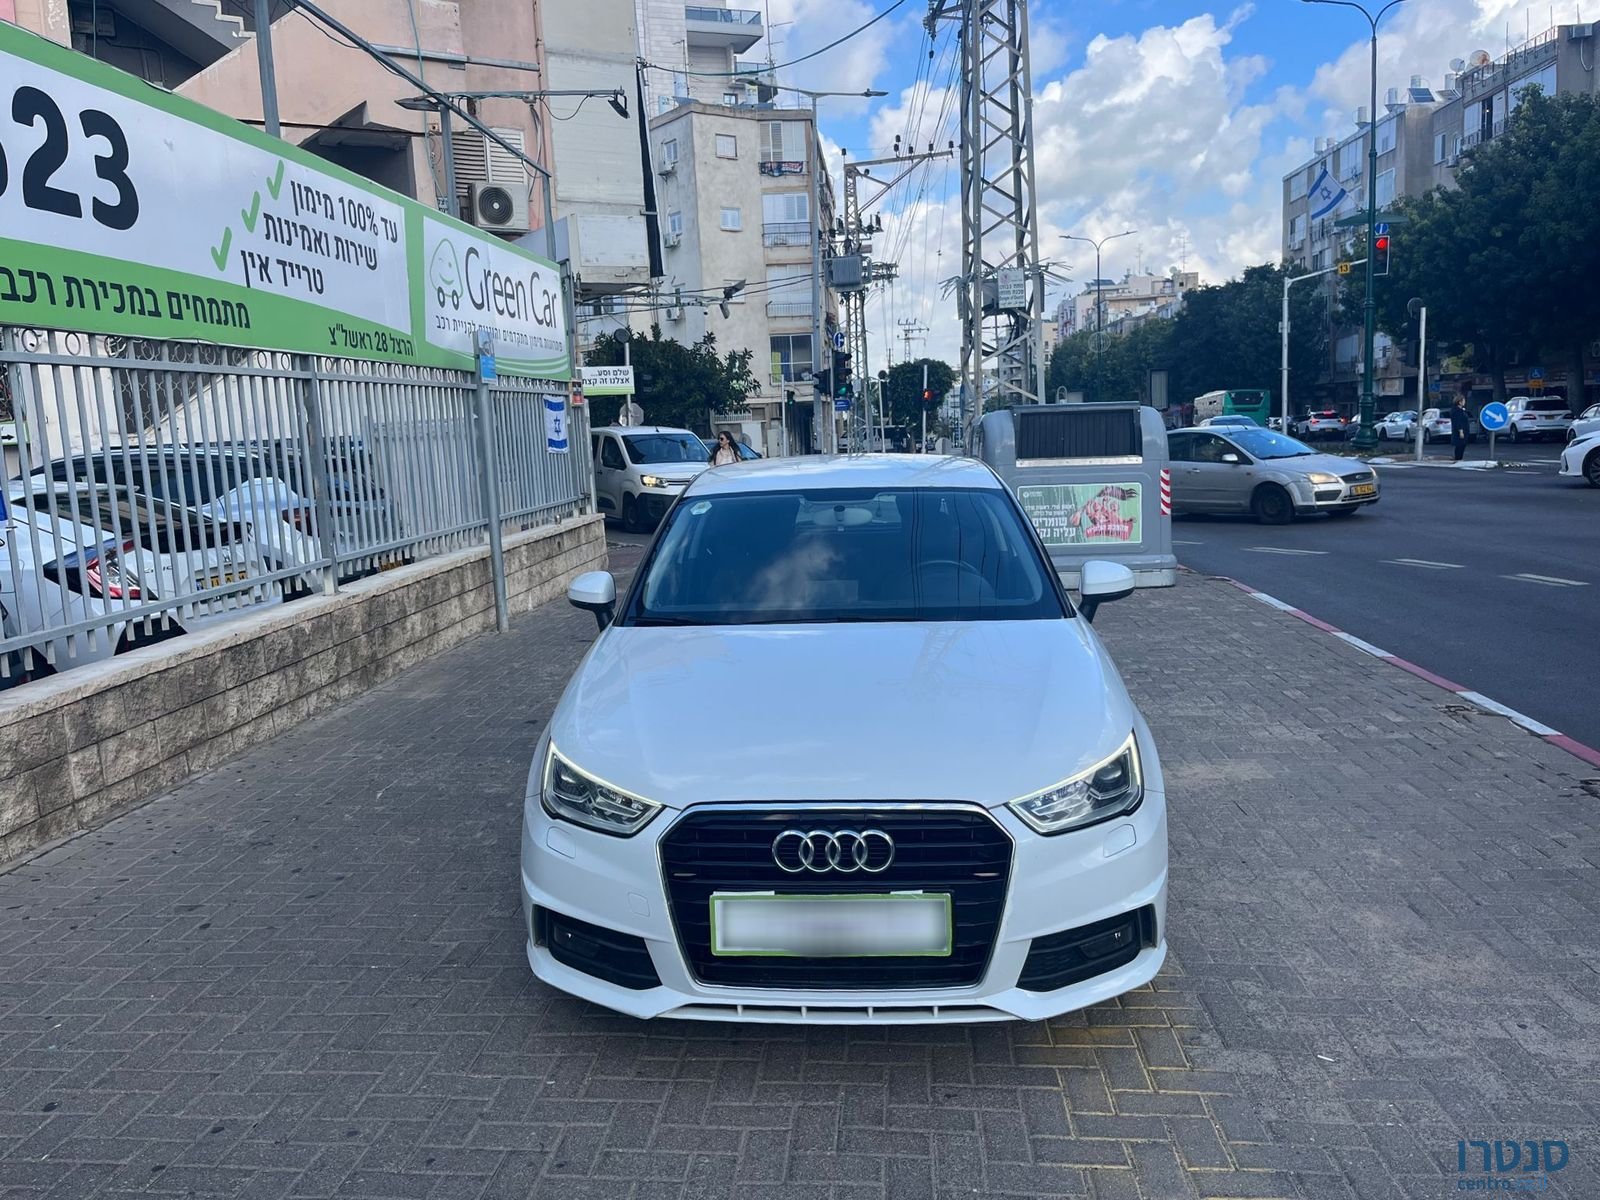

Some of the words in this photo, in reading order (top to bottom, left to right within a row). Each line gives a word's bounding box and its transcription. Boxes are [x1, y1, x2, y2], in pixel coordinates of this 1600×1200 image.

[0, 86, 139, 230] 23
[290, 180, 335, 220] מימון
[339, 196, 379, 236] 100%
[263, 212, 331, 258] ואמינות
[380, 217, 398, 243] עד
[240, 250, 273, 288] אין
[334, 236, 378, 270] שירות
[1340, 264, 1349, 273] 13
[0, 266, 57, 306] רכב
[276, 258, 325, 295] טרייד
[465, 246, 529, 321] Green
[530, 271, 557, 329] Car
[63, 275, 162, 318] במכירת
[166, 290, 251, 329] מתמחים
[435, 315, 451, 331] רכב
[374, 331, 387, 352] 28
[389, 332, 414, 357] הרצל
[582, 377, 598, 387] קצת
[599, 377, 608, 385] זה
[610, 377, 630, 385] אצלנו
[1032, 516, 1068, 527] שומרים
[1053, 526, 1076, 538] עליה
